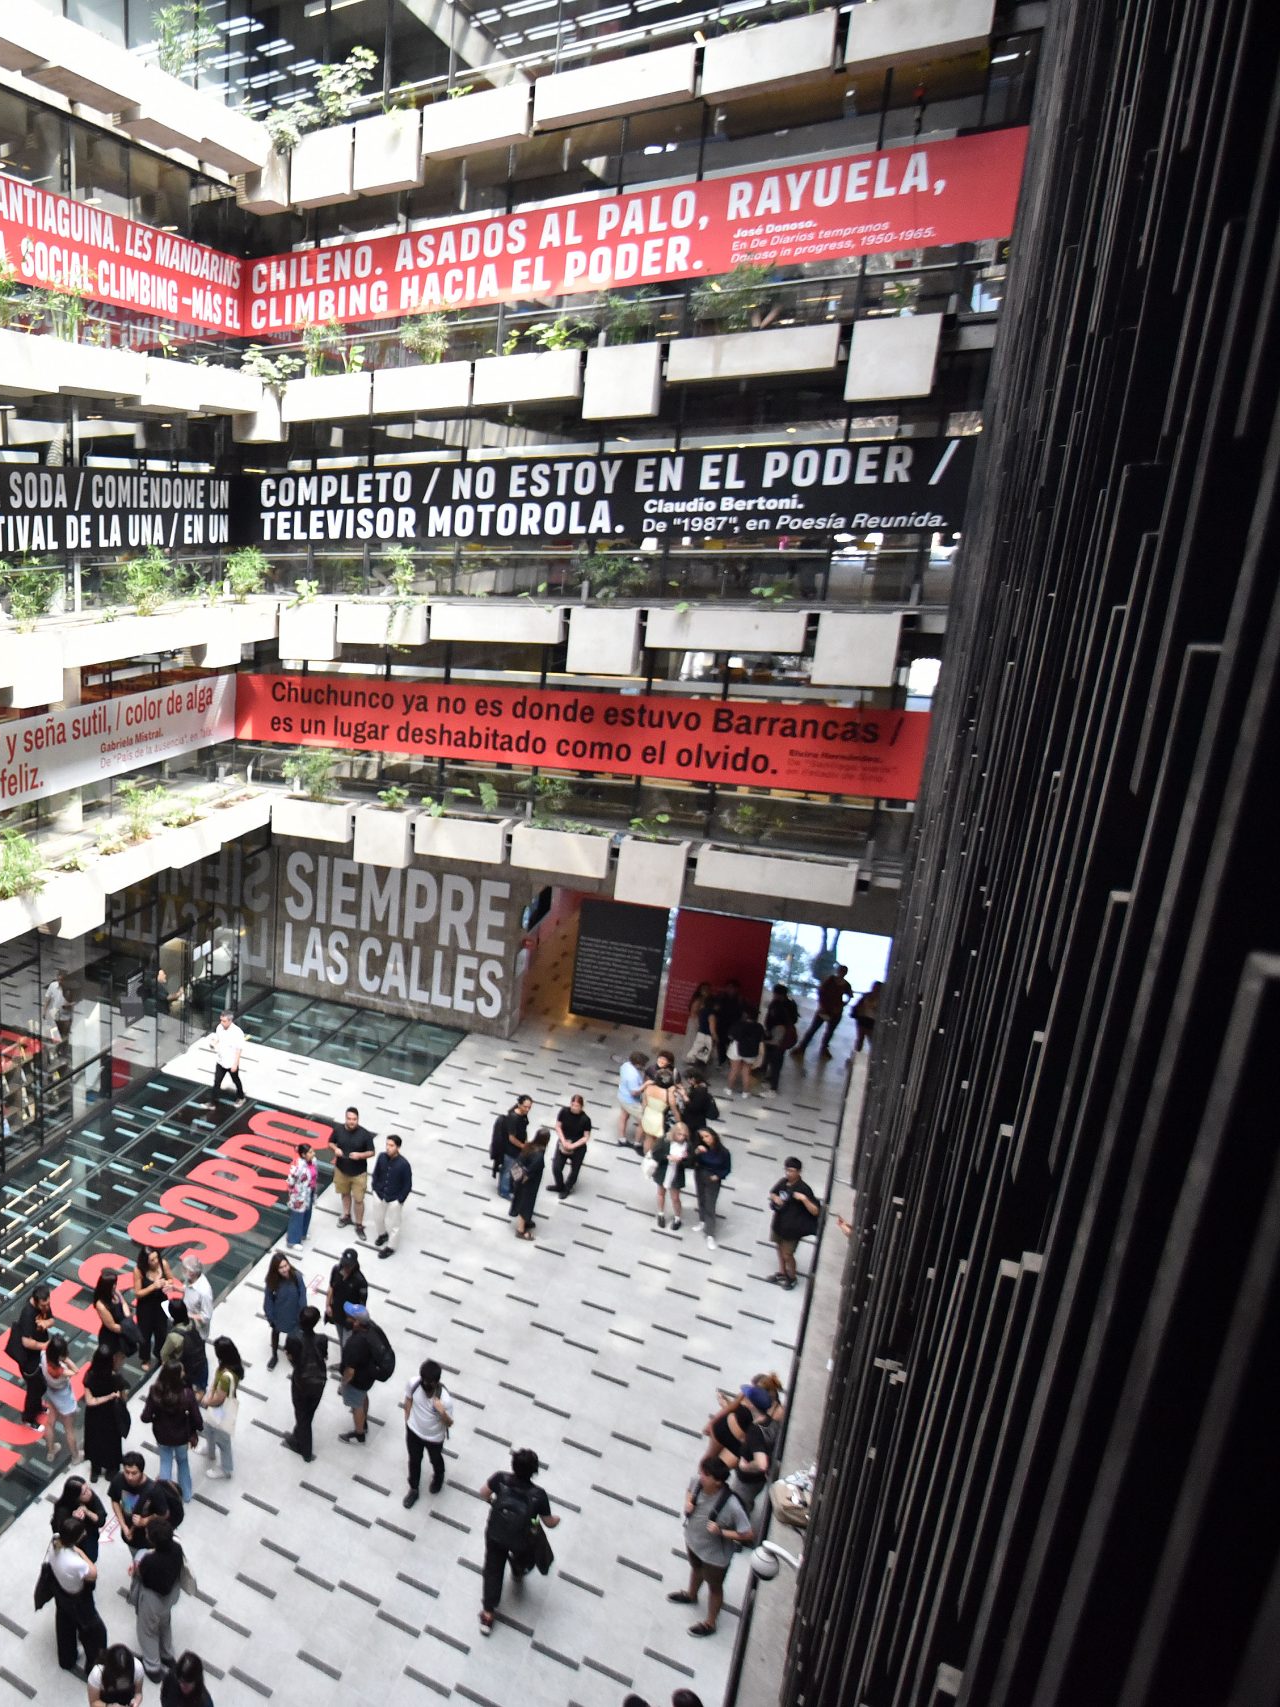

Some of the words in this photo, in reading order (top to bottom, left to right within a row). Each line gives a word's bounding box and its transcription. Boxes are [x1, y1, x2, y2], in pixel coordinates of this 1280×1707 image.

[253, 245, 383, 295] CHILENO.
[394, 218, 527, 272] ASADOS
[539, 210, 583, 249] AL
[597, 190, 709, 241] PALO,
[727, 151, 947, 221] RAYUELA,
[732, 239, 747, 251] En
[750, 238, 767, 249] De
[770, 232, 814, 246] Diarios
[818, 221, 890, 239] tempranos
[733, 224, 763, 239] José
[765, 219, 818, 234] Donoso.
[780, 247, 791, 257] in
[794, 241, 856, 258] progress,
[21, 237, 94, 292] SOCIAL
[97, 260, 178, 314] CLIMBING
[225, 297, 241, 329] EL
[125, 225, 152, 262] LES
[155, 235, 241, 289] MANDARINS
[251, 281, 388, 330] CLIMBING
[400, 264, 499, 310] HACIA
[511, 256, 551, 294] EL
[563, 235, 704, 288] PODER.
[9, 471, 68, 509] SODA
[91, 470, 205, 510] COMIÉNDOME
[210, 480, 230, 510] UN
[260, 470, 412, 508] COMPLETO
[452, 466, 496, 500] NO
[509, 459, 623, 498] ESTOY
[634, 456, 684, 492] EN
[699, 453, 745, 491] EL
[762, 445, 913, 488] PODER
[644, 499, 716, 514] Claudio
[720, 494, 805, 511] Bertoni.
[65, 514, 92, 549] DE
[98, 514, 121, 548] LA
[128, 514, 164, 547] UNA
[183, 514, 203, 544] EN
[208, 514, 229, 543] UN
[260, 506, 416, 541] TELEVISOR
[427, 500, 625, 538] MOTOROLA.
[642, 519, 667, 533] De
[745, 518, 770, 531] en
[776, 513, 846, 529] Poesía
[851, 511, 949, 528] Reunida.
[6, 733, 17, 765] y
[23, 717, 67, 753] seña
[72, 704, 112, 740] sutil,
[125, 696, 163, 726] color
[166, 690, 183, 716] de
[186, 684, 213, 713] alga
[100, 736, 133, 753] Gabriela
[135, 728, 163, 744] Mistral.
[271, 682, 394, 710] Chuchunco
[402, 692, 428, 715] ya
[436, 695, 466, 715] no
[475, 698, 503, 717] es
[512, 696, 594, 724] donde
[603, 704, 701, 732] estuvo
[712, 708, 879, 743] Barrancas
[270, 715, 293, 732] es
[300, 717, 326, 735] un
[333, 715, 390, 744] lugar
[397, 721, 546, 755] deshabitado
[556, 738, 631, 763] como
[641, 740, 666, 765] el
[676, 744, 778, 775] olvido.
[0, 763, 44, 799] feliz.
[284, 850, 510, 957] SIEMPRE
[283, 921, 350, 986] LAS
[357, 936, 504, 1020] CALLES
[127, 1111, 334, 1264] SORDO
